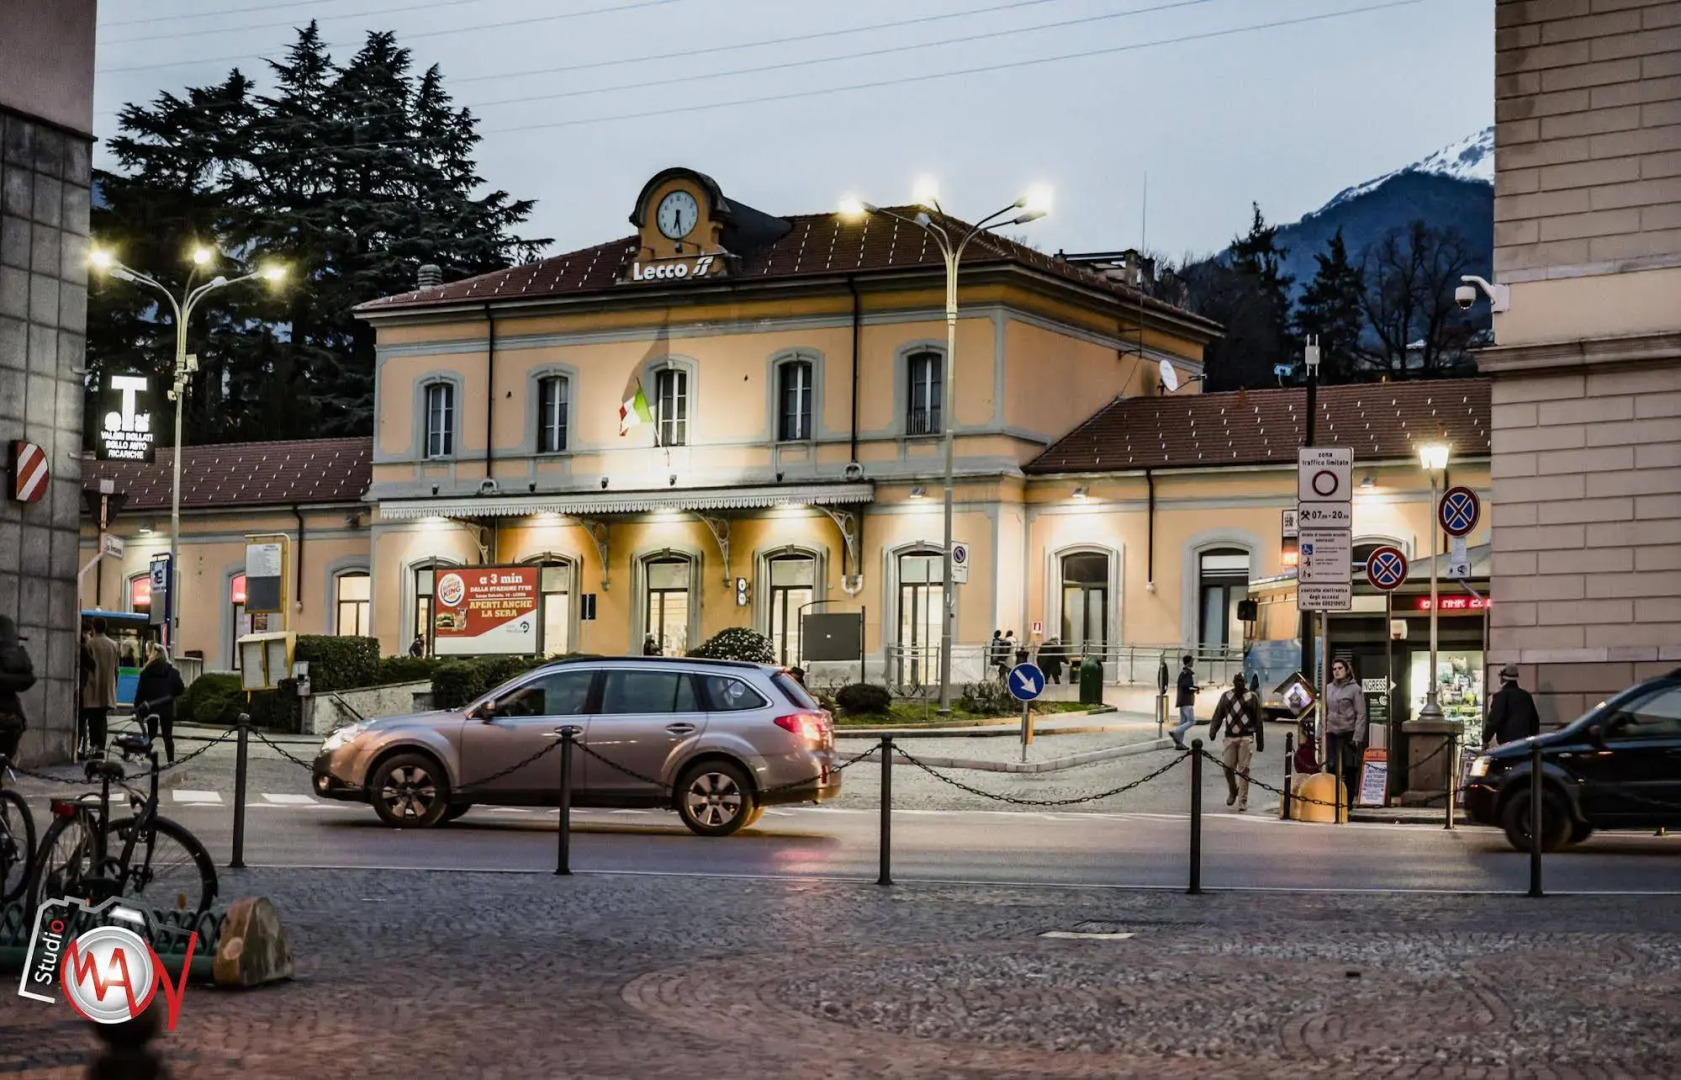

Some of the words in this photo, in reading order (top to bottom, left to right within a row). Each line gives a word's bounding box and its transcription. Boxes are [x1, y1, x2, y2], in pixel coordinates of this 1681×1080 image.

[633, 262, 688, 280] Lecco
[125, 432, 153, 442] BOLLATI
[105, 440, 128, 450] BOLLO
[129, 441, 147, 451] AUTO
[108, 449, 144, 459] RICARICHE
[490, 573, 498, 584] 3
[501, 573, 522, 584] min
[443, 587, 461, 598] KING
[469, 600, 500, 609] APERTI
[502, 600, 532, 608] ANCHE
[495, 609, 517, 617] SERA
